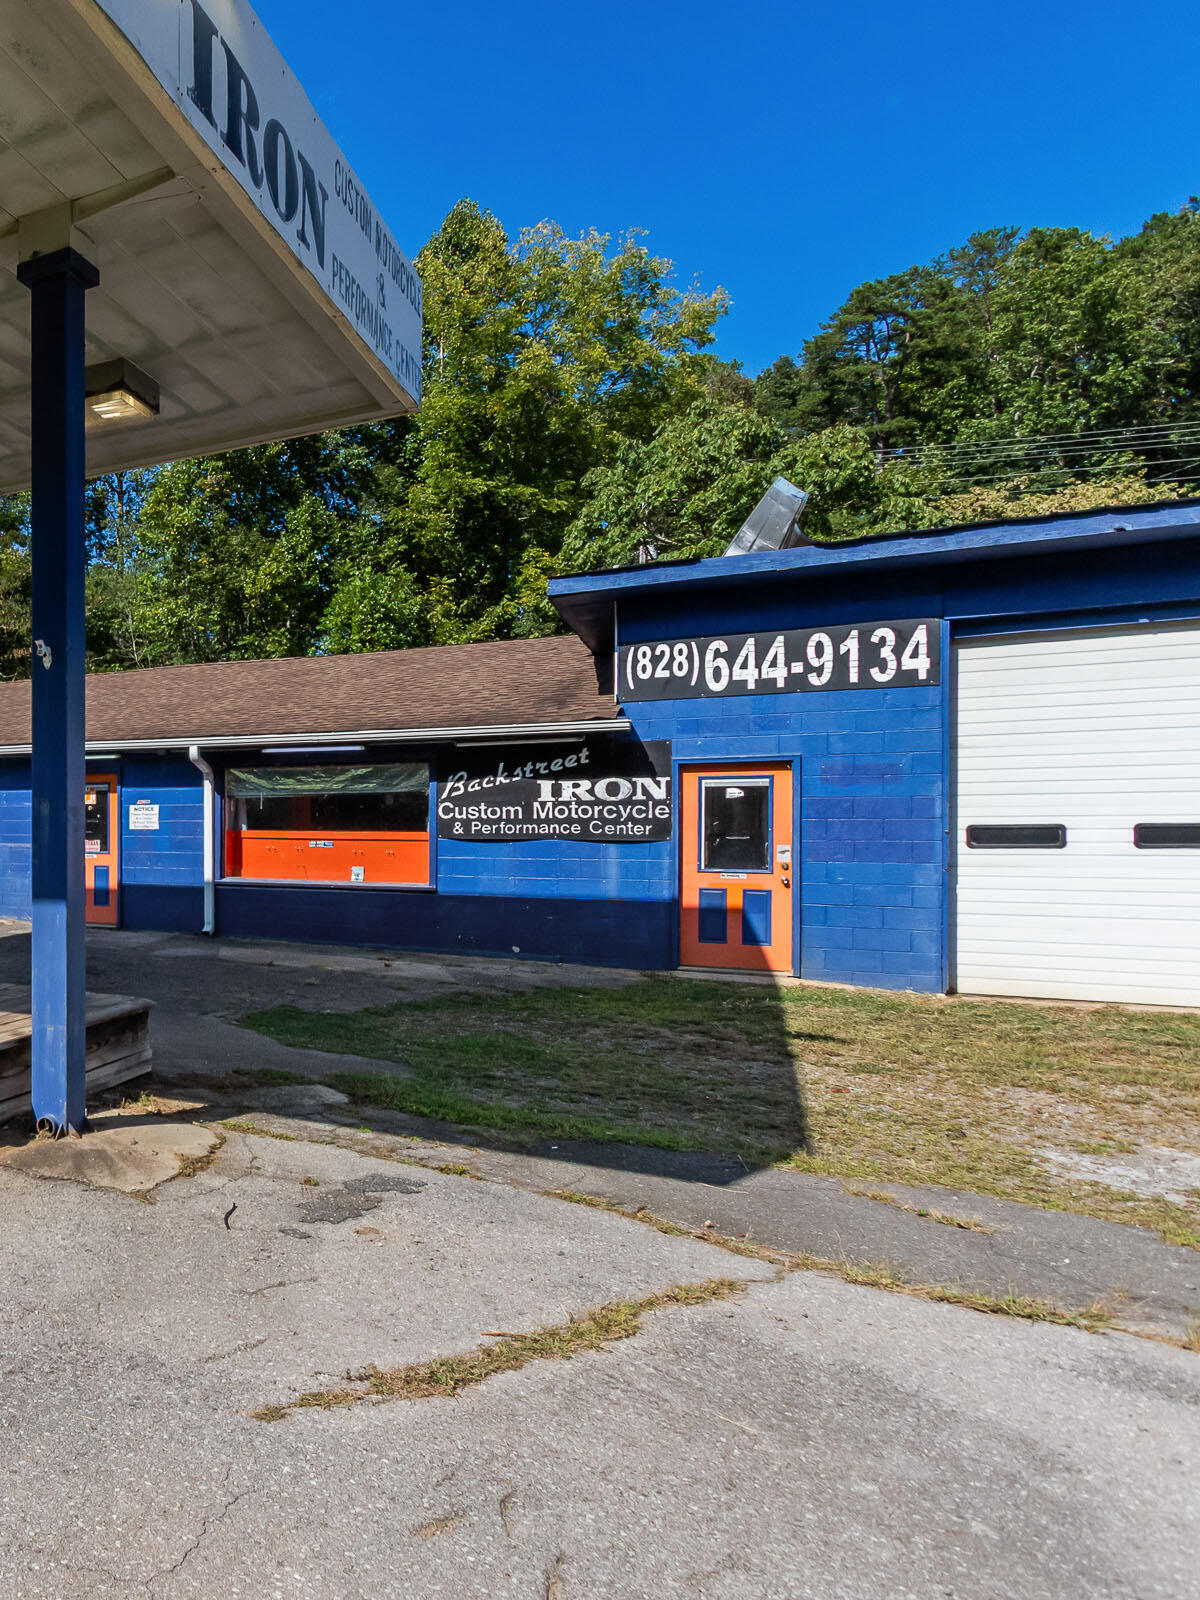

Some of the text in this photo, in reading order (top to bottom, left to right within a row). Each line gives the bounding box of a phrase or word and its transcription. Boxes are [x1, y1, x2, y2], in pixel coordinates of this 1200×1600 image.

[187, 0, 328, 271] IRON
[335, 159, 421, 318] CUSTOM MOTORCYCLE
[332, 253, 392, 362] PERFORMANCE
[378, 272, 387, 312] &
[440, 747, 590, 800] Backstreet
[537, 777, 670, 802] IRON
[438, 801, 670, 821] Custom Motorcycle
[453, 820, 652, 835] & Performance Center
